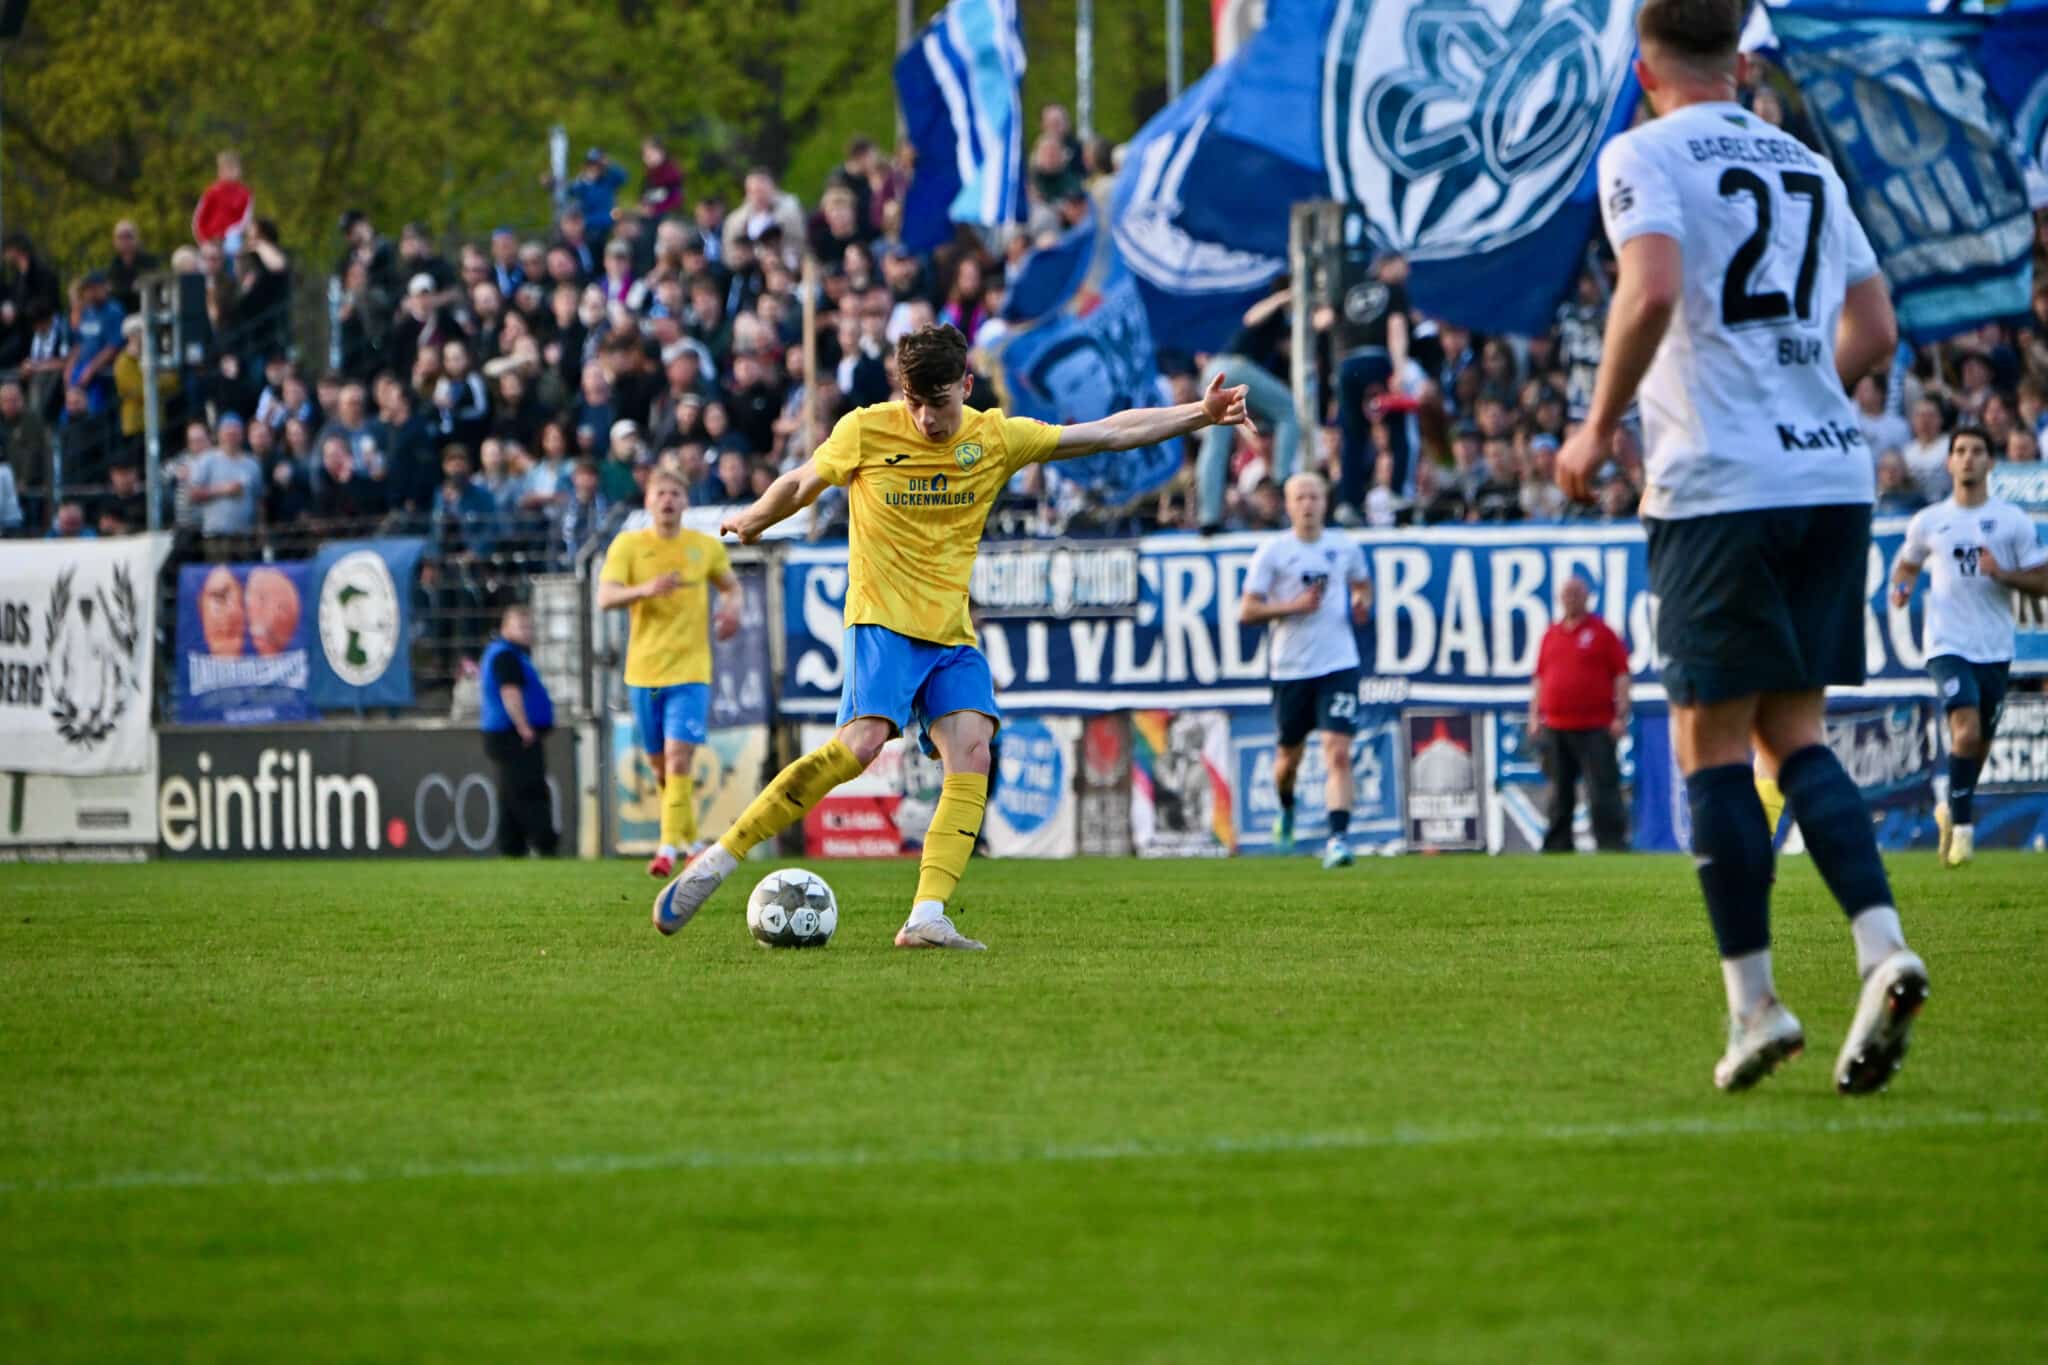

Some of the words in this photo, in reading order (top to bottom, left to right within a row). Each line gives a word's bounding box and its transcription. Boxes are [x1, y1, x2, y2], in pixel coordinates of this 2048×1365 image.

[1719, 167, 1825, 326] 27
[885, 491, 975, 506] LUCKENWALDER
[909, 479, 928, 491] DIE
[159, 748, 562, 851] einfilm.co
